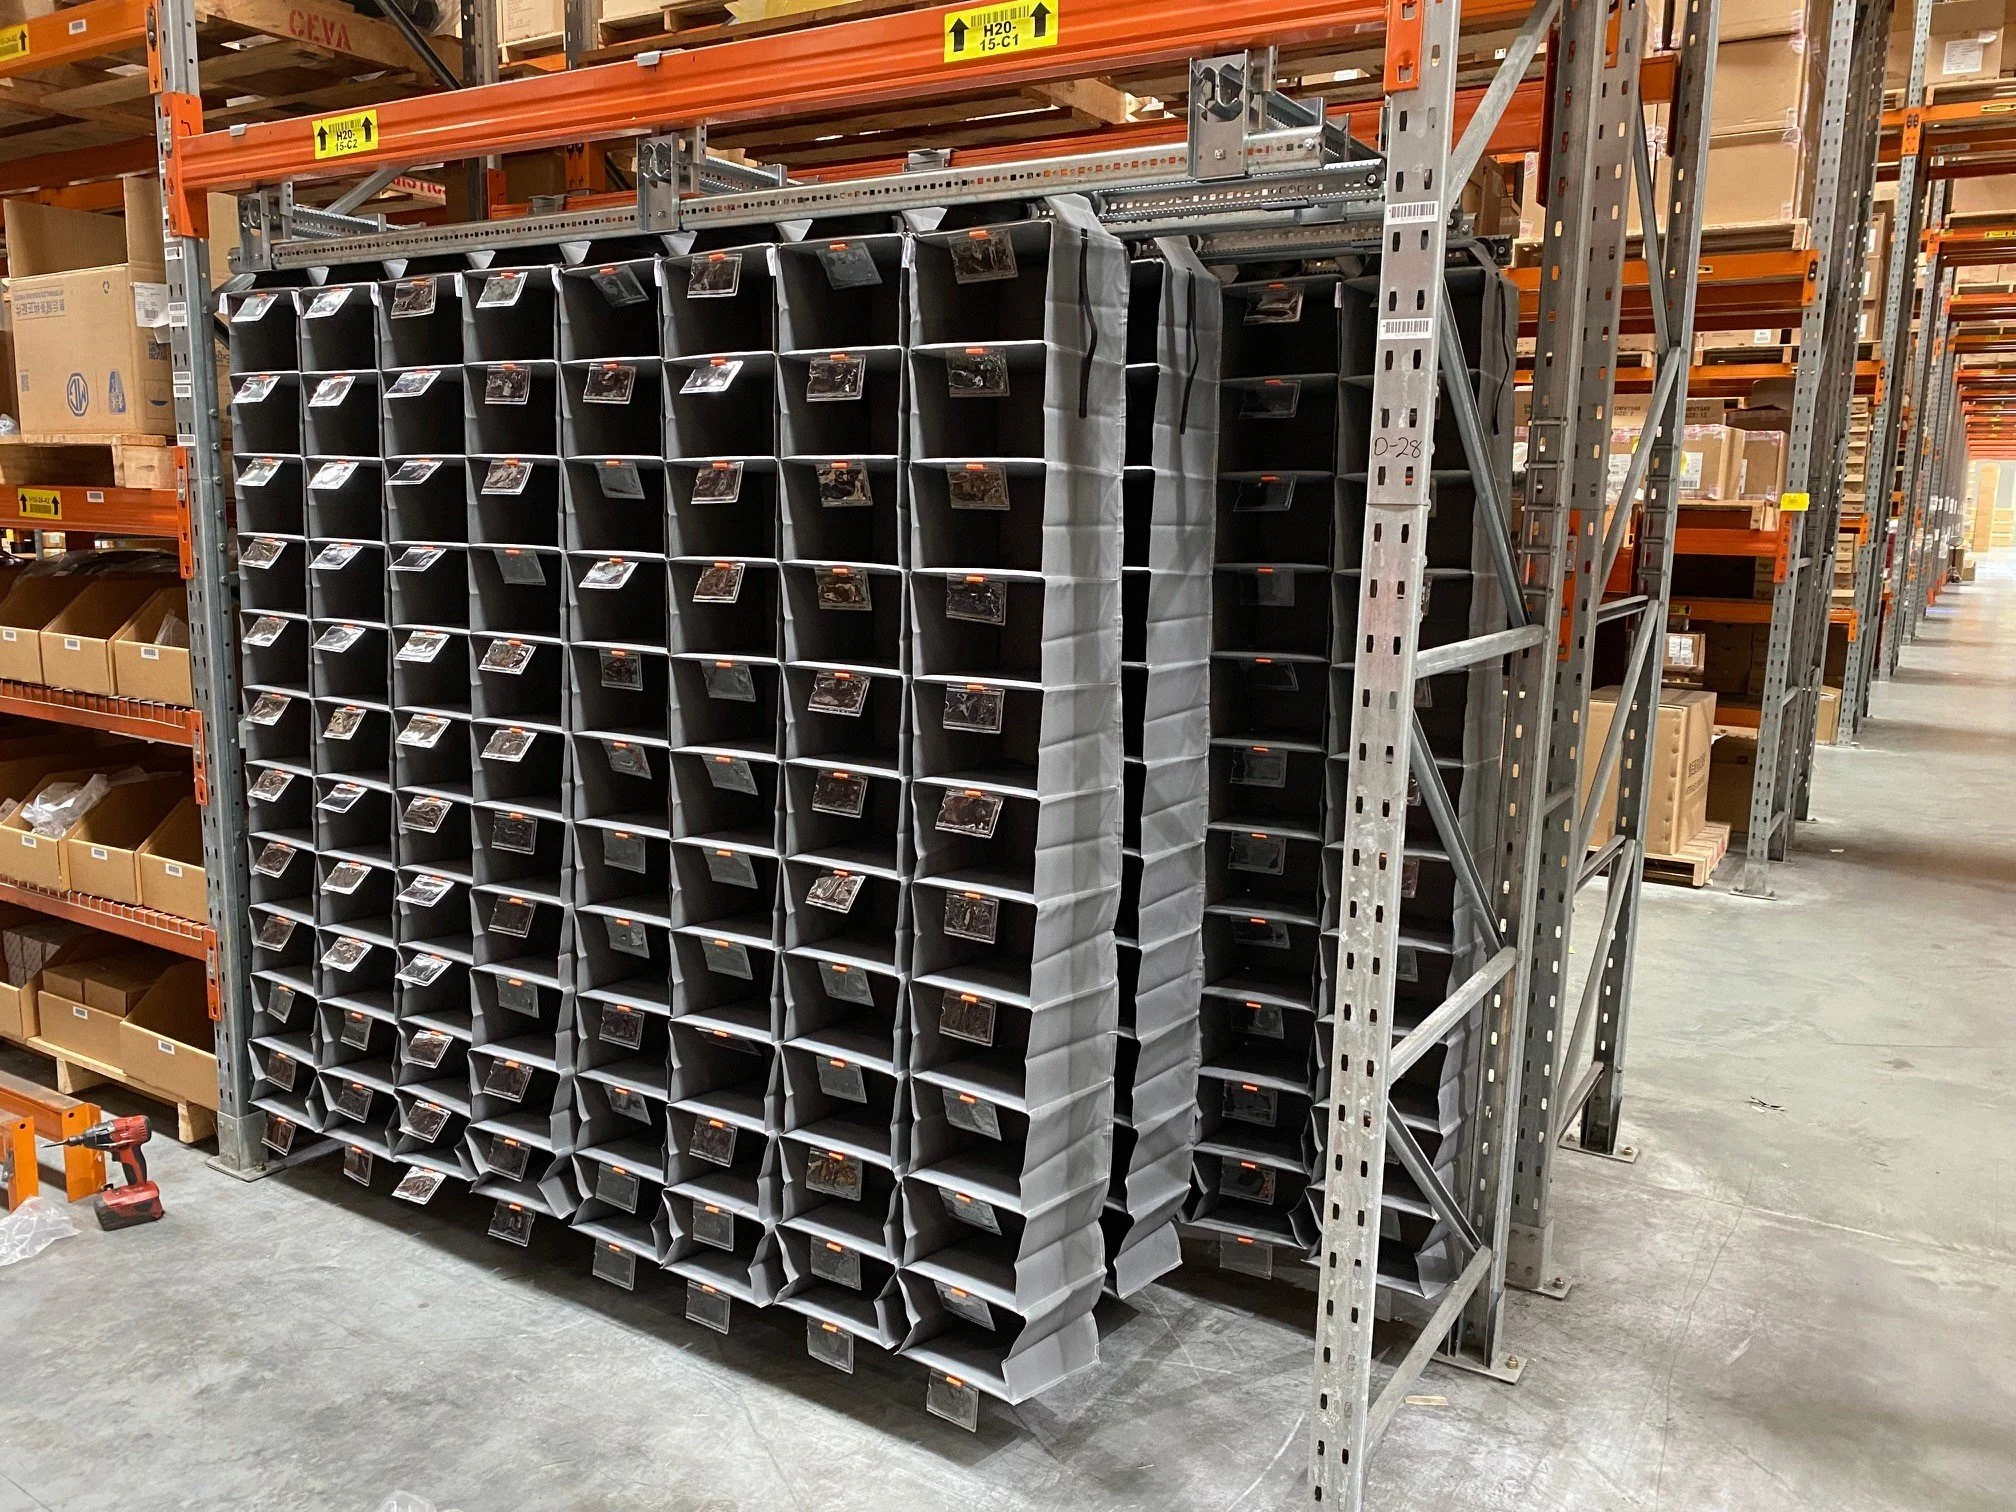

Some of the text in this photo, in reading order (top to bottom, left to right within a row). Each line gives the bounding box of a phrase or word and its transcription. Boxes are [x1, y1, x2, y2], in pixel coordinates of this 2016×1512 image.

[289, 9, 352, 51] CEVA
[984, 21, 1016, 37] H20-
[980, 33, 1019, 51] 15-C1
[336, 129, 356, 141] H20-
[335, 139, 358, 152] 15-C2
